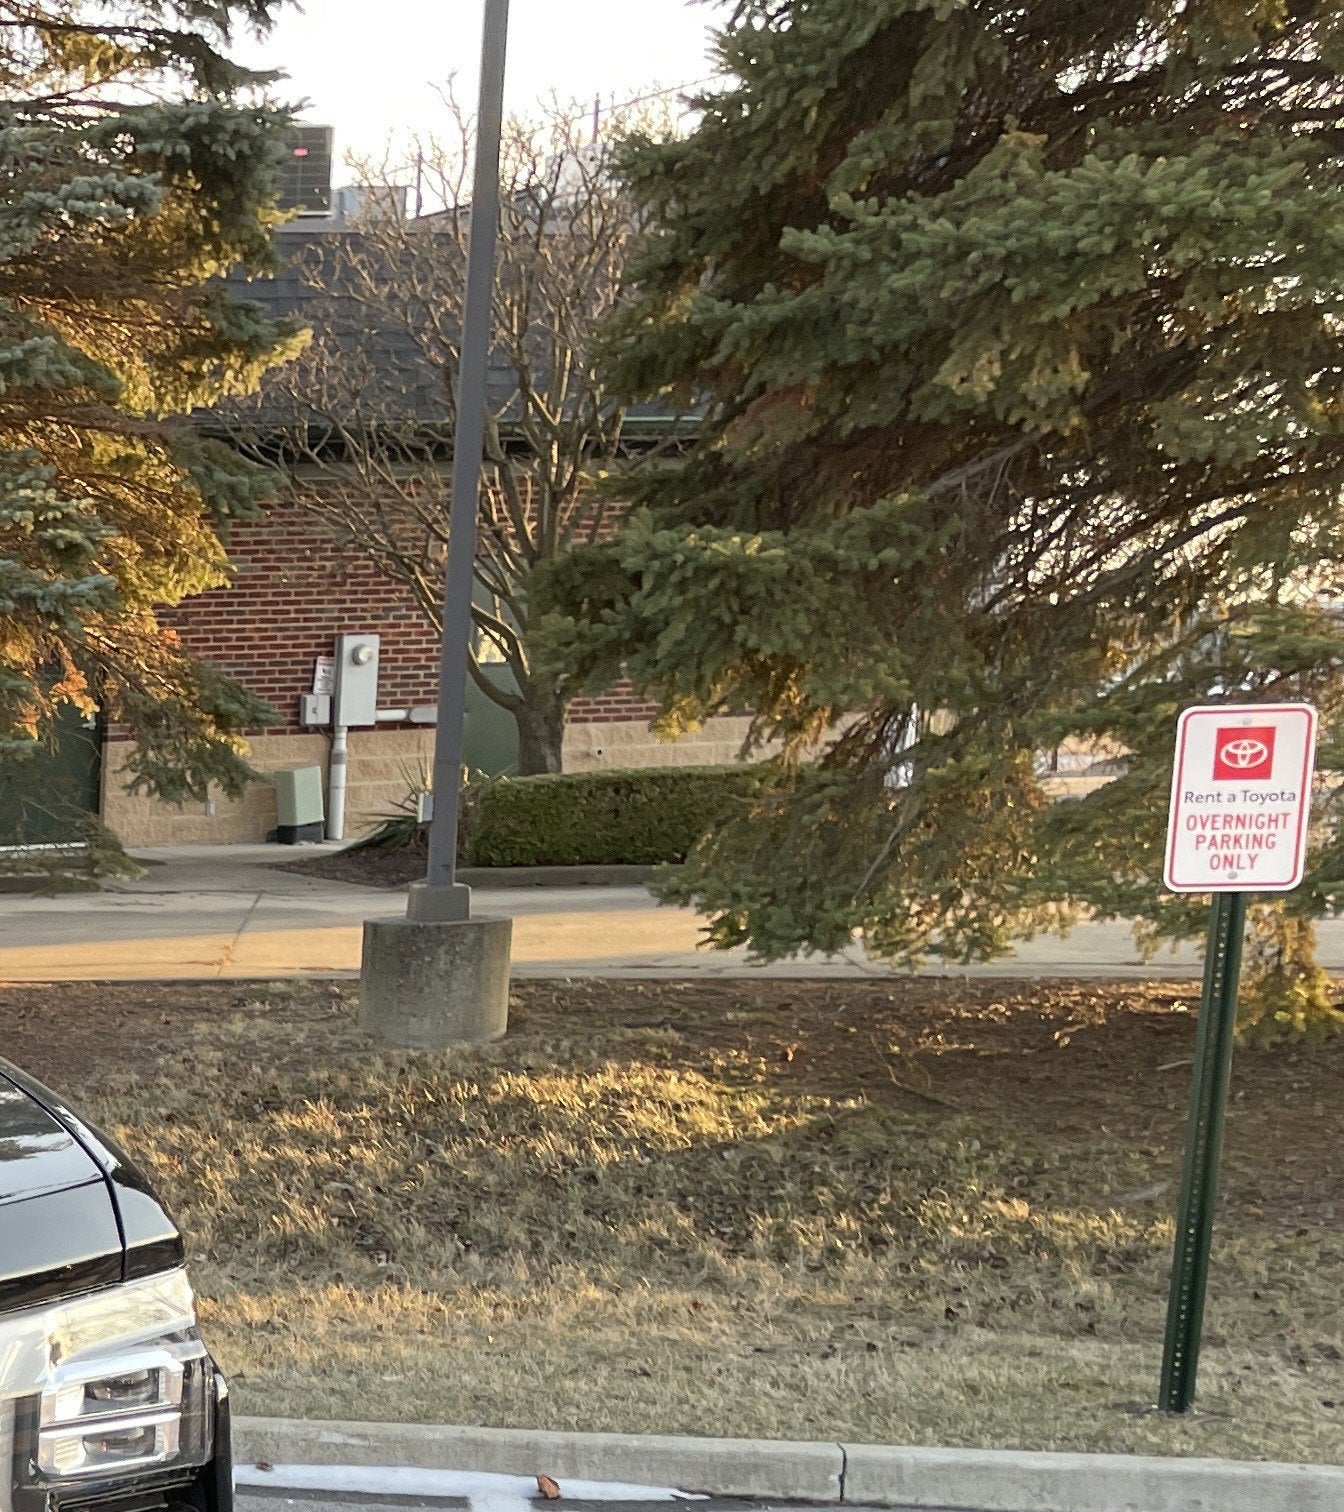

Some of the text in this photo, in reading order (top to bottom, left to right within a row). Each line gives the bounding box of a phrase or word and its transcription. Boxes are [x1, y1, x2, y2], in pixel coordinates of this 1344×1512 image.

[1184, 789, 1297, 805] Rent a Toyota
[1186, 812, 1291, 831] OVERNIGHT
[1195, 833, 1277, 851] PARKING
[1209, 853, 1259, 870] ONLY
